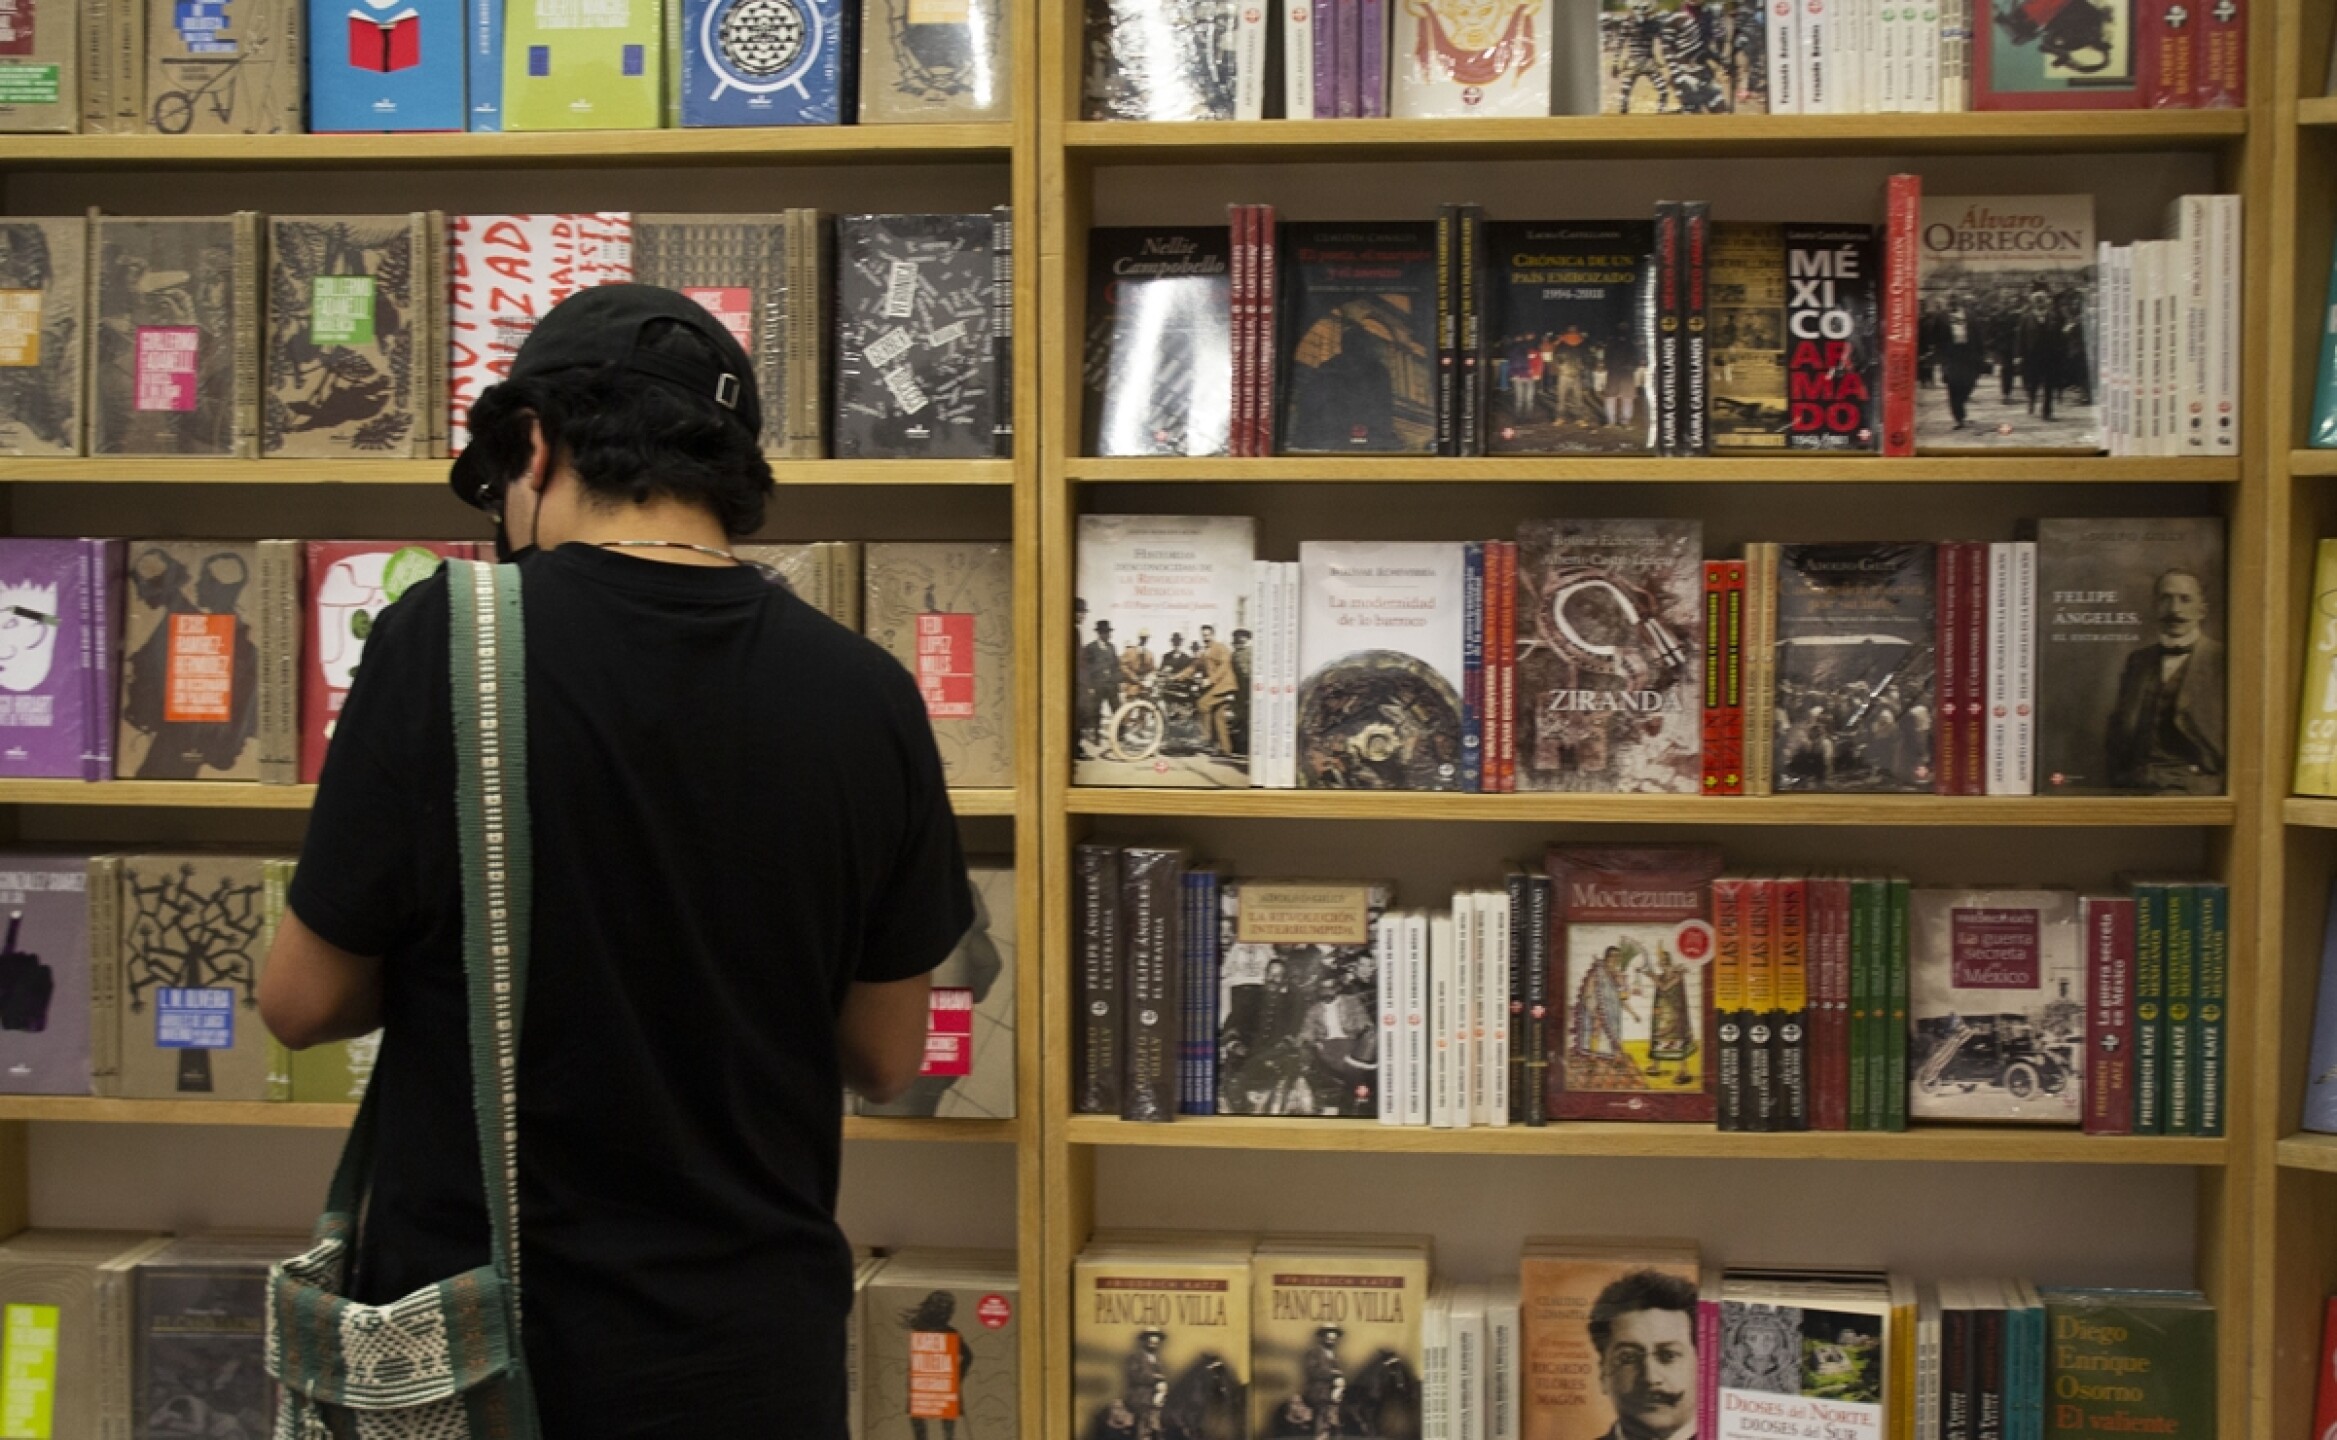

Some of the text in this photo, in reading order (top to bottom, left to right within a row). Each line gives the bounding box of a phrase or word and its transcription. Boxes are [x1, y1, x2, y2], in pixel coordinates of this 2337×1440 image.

[1958, 203, 2046, 229] Álvaro
[1923, 223, 2083, 252] OBREGÓN
[1788, 243, 1860, 278] MÉ
[1788, 279, 1836, 308] XI
[1789, 309, 1853, 340] CO
[1790, 341, 1852, 370] AR
[1662, 337, 1676, 410] CASTELLANOS
[1689, 337, 1704, 410] CASTELLANOS
[1790, 371, 1869, 400] MA
[1790, 402, 1860, 432] DO
[1350, 594, 1437, 609] modernidad
[2052, 590, 2119, 604] FELIPE
[1336, 612, 1355, 626] de
[1373, 611, 1427, 627] barroco
[1570, 882, 1699, 908] Moctezuma
[1718, 940, 1740, 967] LAS
[1749, 941, 1770, 968] LAS
[1782, 941, 1801, 967] LAS
[1958, 932, 2034, 949] La guerra
[1963, 948, 2028, 960] secreta
[1085, 943, 1098, 990] FELIPE
[1135, 951, 1149, 1000] FELIPE
[1962, 967, 2031, 984] México
[2096, 913, 2115, 1027] La guerra secreta
[1102, 977, 1113, 991] EL
[1152, 987, 1164, 1000] EL
[2111, 960, 2126, 1027] en México
[2140, 1026, 2155, 1126] FRIEDRICH KATZ
[2171, 1026, 2187, 1126] FRIEDRICH KATZ
[2202, 1027, 2217, 1128] FRIEDRICH KATZ
[1094, 1293, 1228, 1326] PANCHO VILLA
[1272, 1289, 1404, 1323] PANCHO VILLA
[2056, 1315, 2128, 1345] Diego
[2055, 1345, 2153, 1376] Enrique
[2055, 1376, 2145, 1402] Osorno
[1724, 1392, 1784, 1416] DIOSES
[1808, 1402, 1876, 1427] NORTE
[2056, 1404, 2179, 1432] El valiente
[1739, 1416, 1800, 1434] DIOSES
[1823, 1422, 1859, 1439] SUR
